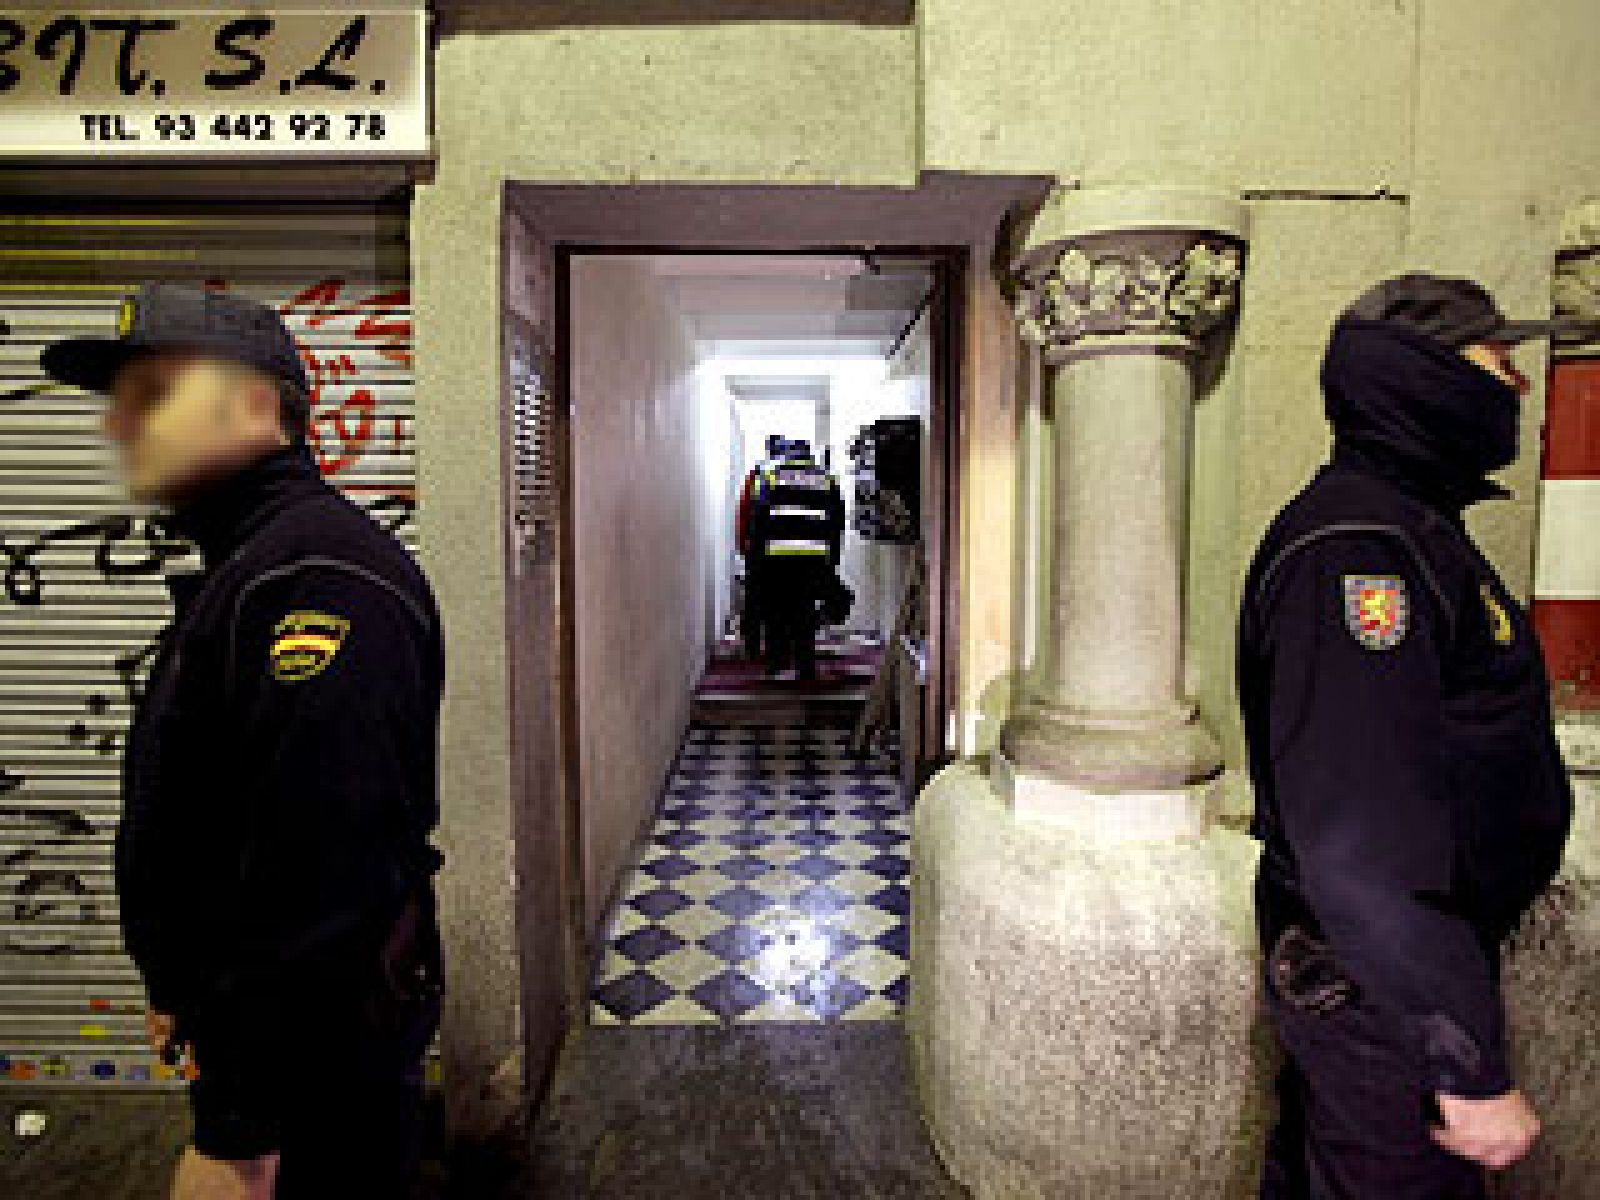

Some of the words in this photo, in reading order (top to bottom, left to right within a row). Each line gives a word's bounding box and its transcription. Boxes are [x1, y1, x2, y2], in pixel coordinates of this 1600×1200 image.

[205, 14, 386, 96] S.L.
[155, 114, 196, 140] 93
[209, 114, 271, 140] 442
[289, 114, 331, 140] 92
[345, 114, 386, 140] 78
